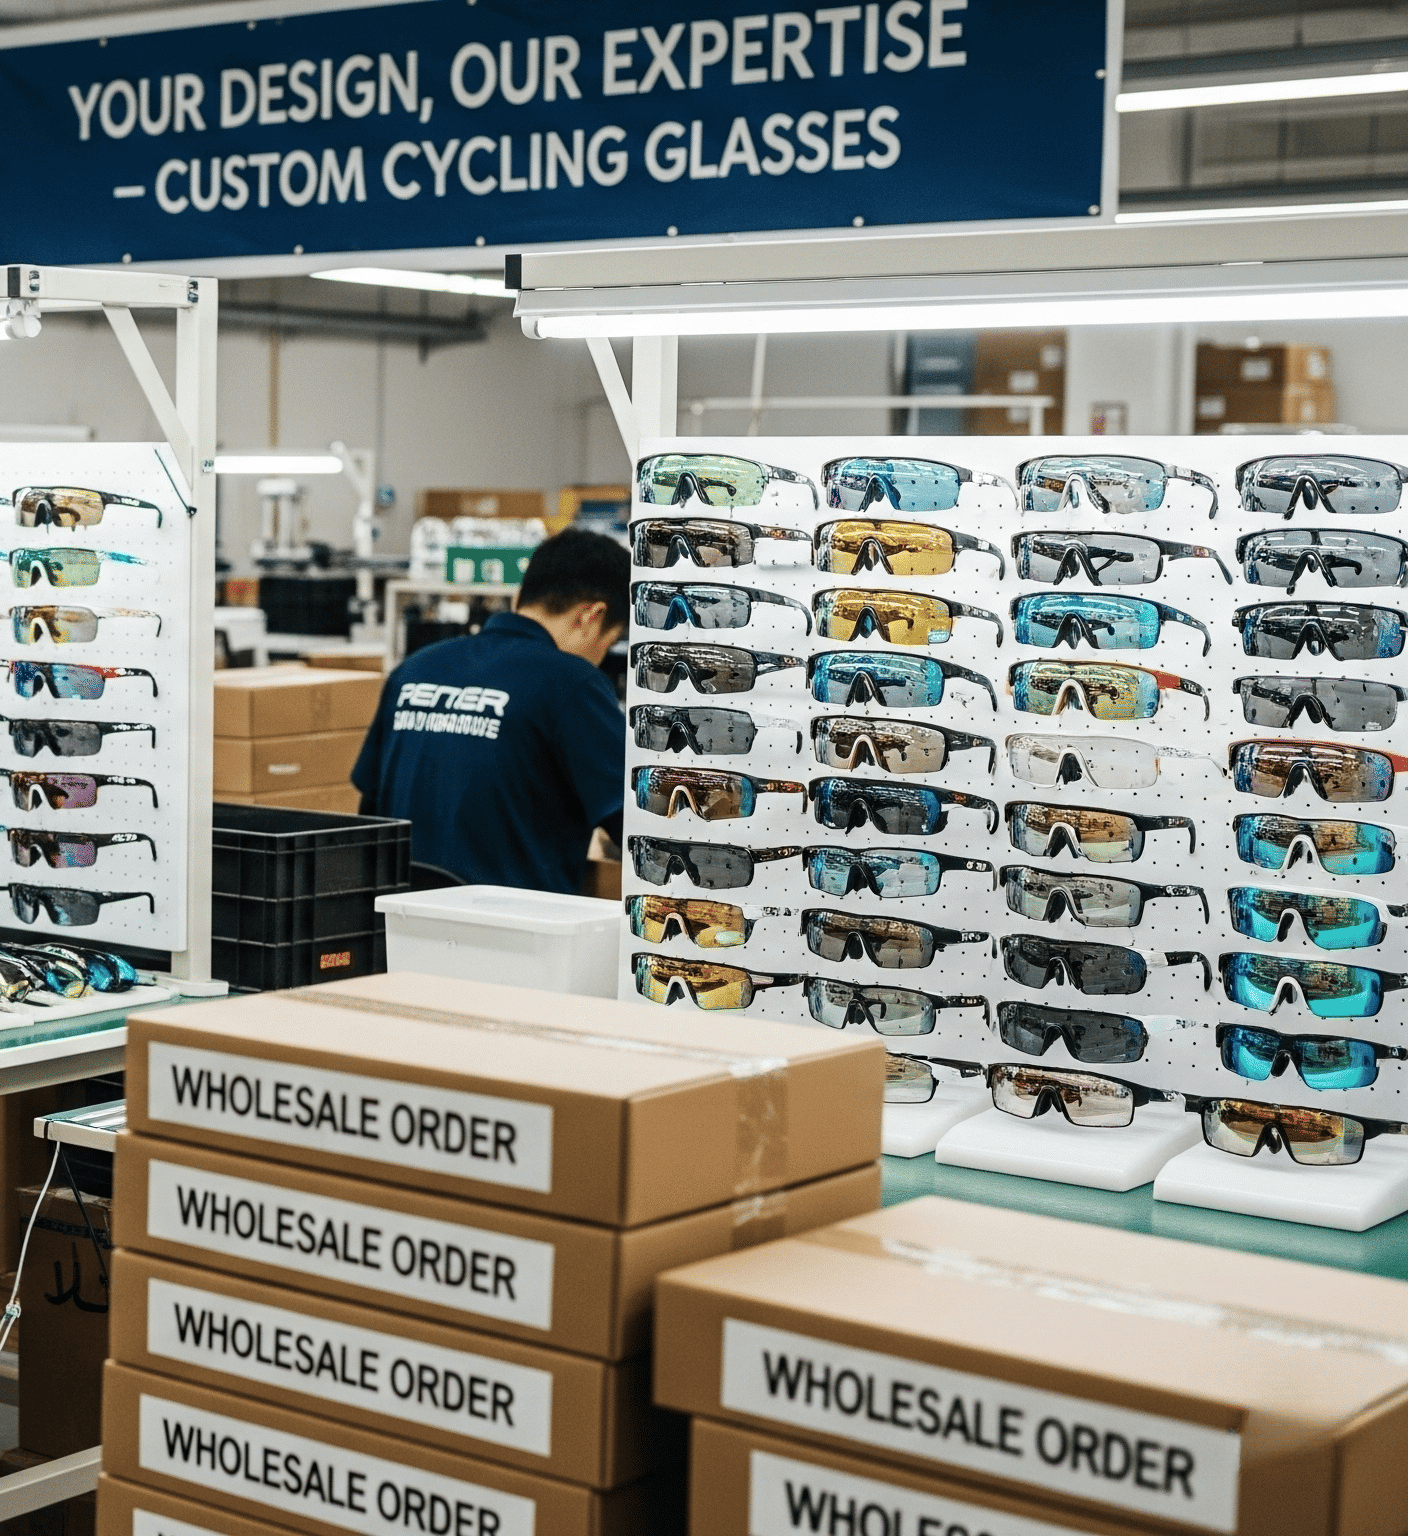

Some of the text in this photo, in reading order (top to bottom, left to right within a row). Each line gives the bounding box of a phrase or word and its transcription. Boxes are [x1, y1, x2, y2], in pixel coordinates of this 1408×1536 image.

[68, 0, 969, 140] YOUR DESIGN, OUR EXPERTISE
[154, 147, 367, 214] CUSTOM
[381, 125, 629, 200] CYCLING
[644, 105, 902, 183] GLASSES
[170, 1063, 518, 1165] WHOLESALE ORDER
[176, 1184, 517, 1301] WHOLESALE ORDER
[173, 1302, 515, 1427] WHOLESALE ORDER
[762, 1350, 1196, 1498] WHOLESALE ORDER
[162, 1417, 501, 1536] WHOLESALE ORDER
